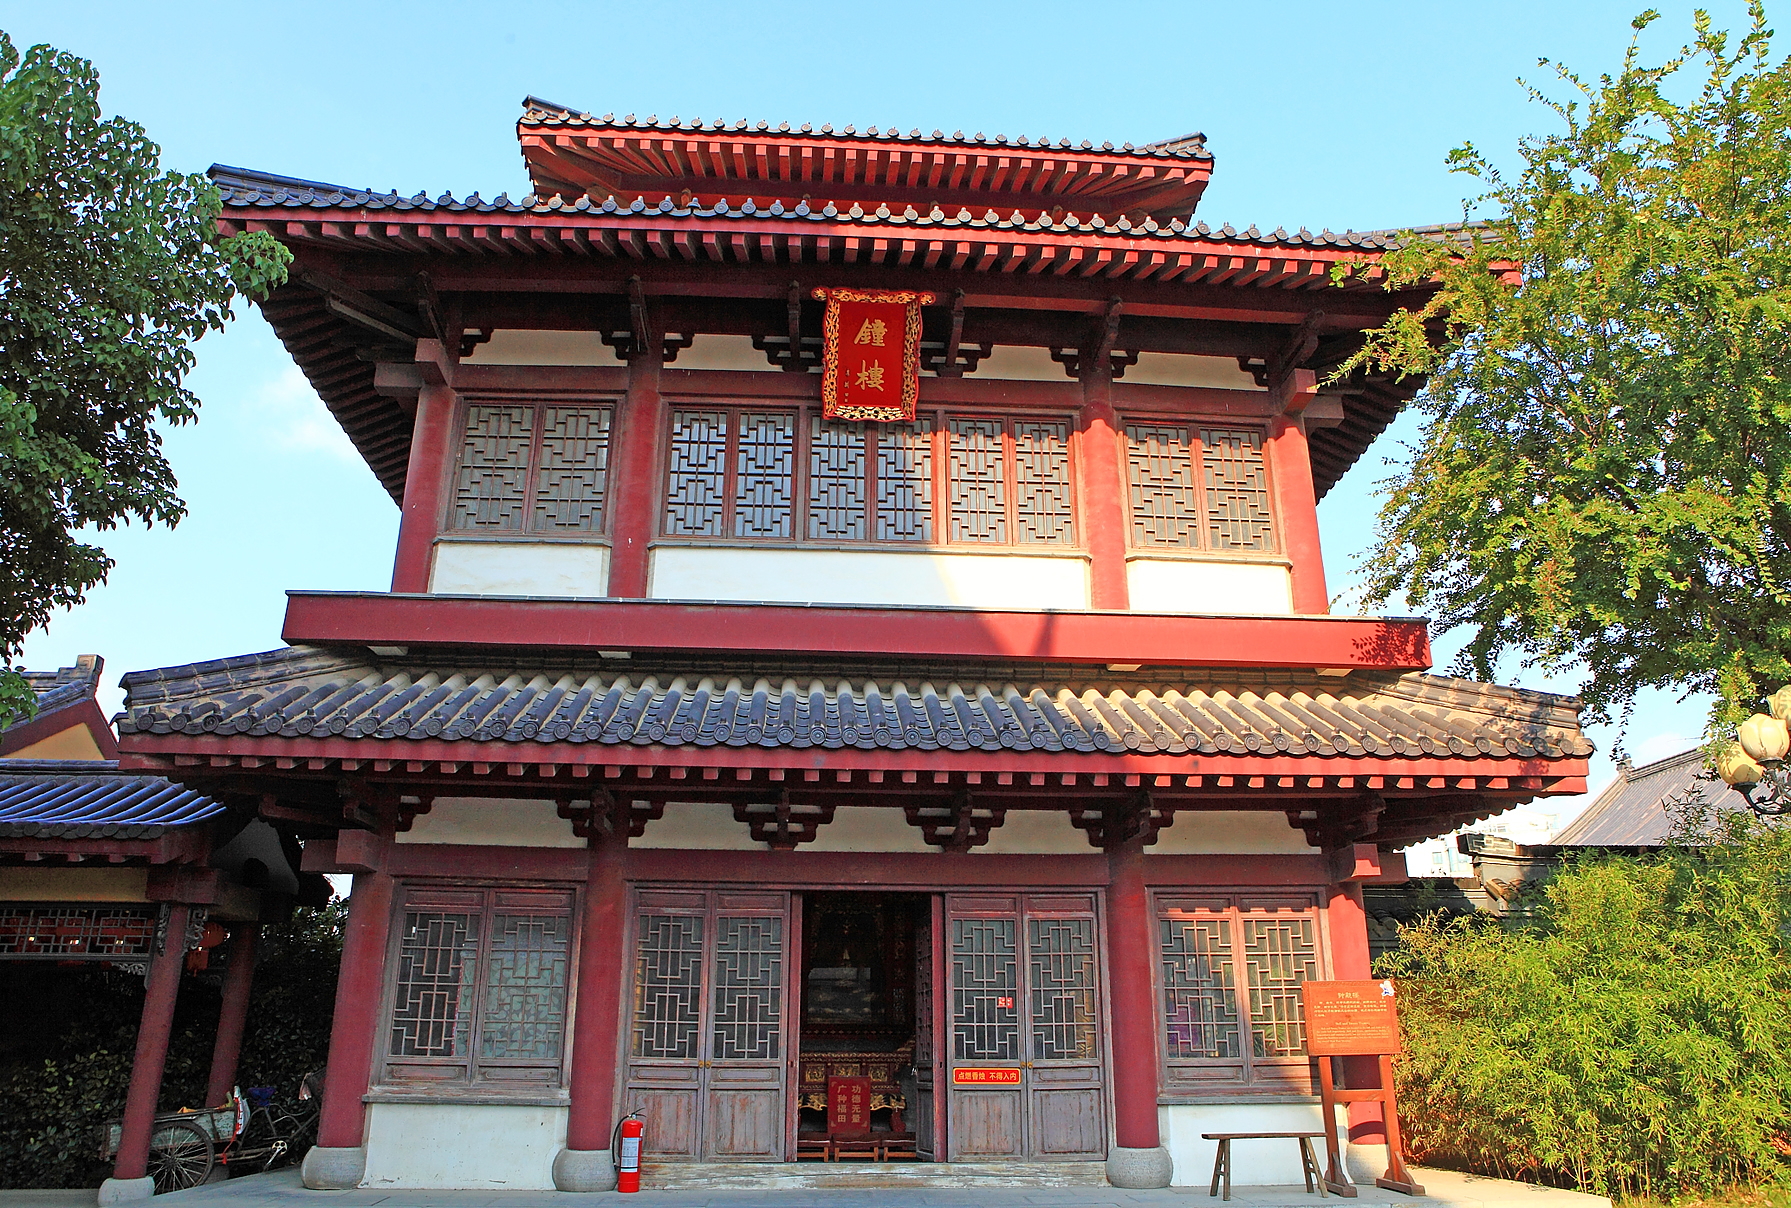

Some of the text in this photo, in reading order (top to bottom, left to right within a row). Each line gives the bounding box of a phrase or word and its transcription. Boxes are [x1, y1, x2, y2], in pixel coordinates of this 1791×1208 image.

[854, 318, 887, 392] 鐘樓
[989, 1072, 1017, 1080] 不得入内
[837, 1085, 847, 1123] 广种福田
[851, 1085, 861, 1123] 功德无量
